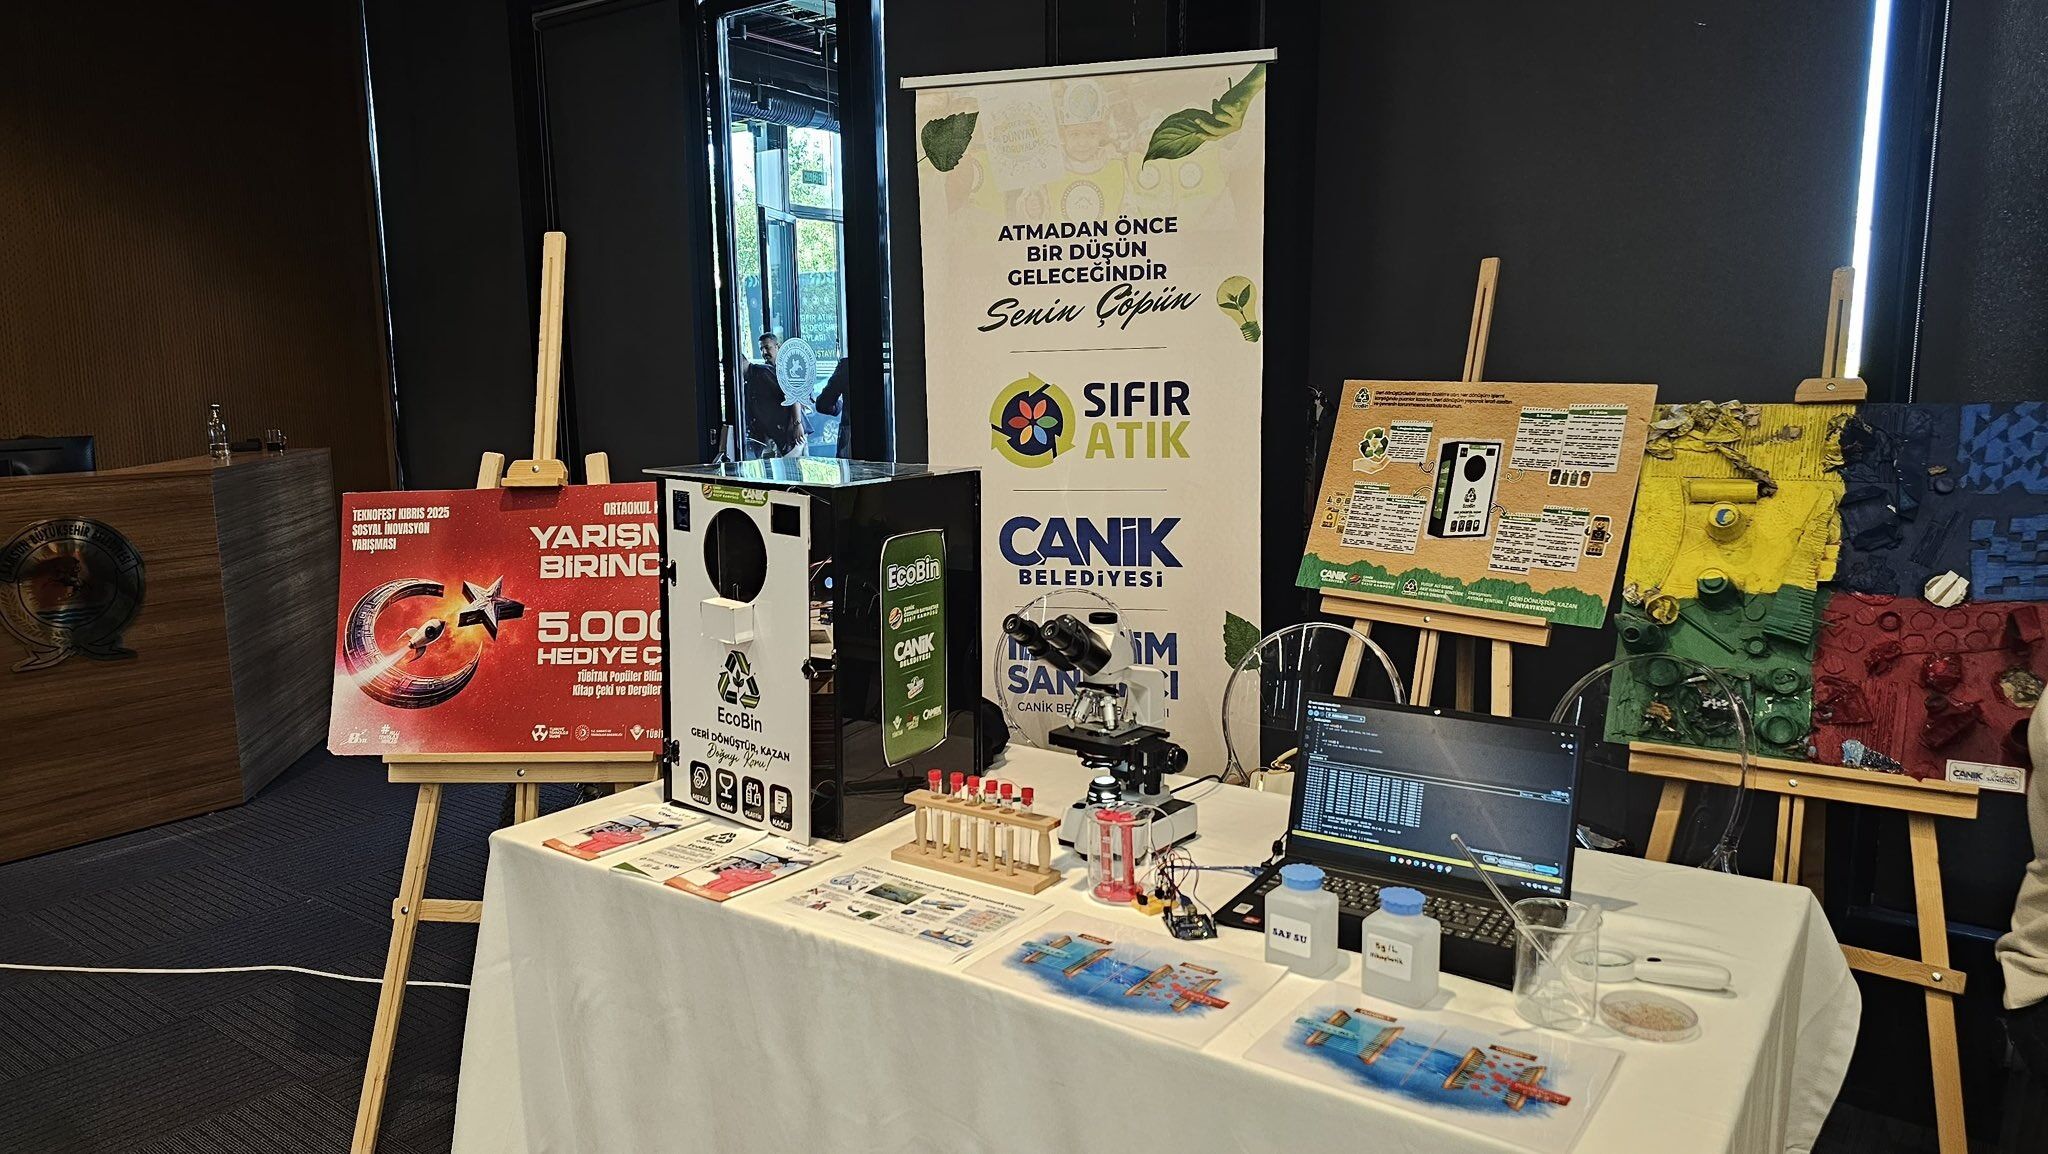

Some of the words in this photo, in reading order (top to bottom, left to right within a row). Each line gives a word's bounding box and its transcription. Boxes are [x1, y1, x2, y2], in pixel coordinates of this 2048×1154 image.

[998, 220, 1108, 242] ATMADAN
[1115, 215, 1178, 235] ÖNCE
[1027, 244, 1062, 262] BİR
[1069, 241, 1147, 264] DÜŞÜN
[1007, 259, 1168, 286] GELECEĞİNDİR
[977, 298, 1085, 332] Senin
[1096, 283, 1202, 331] Çöpün
[1083, 380, 1191, 417] SIFIR
[1085, 420, 1191, 459] ATIK
[352, 507, 397, 522] TEKNOFEST
[398, 507, 425, 520] KIBRIS
[426, 506, 450, 519] 2025
[603, 501, 652, 516] ORTAOKUL
[352, 522, 383, 536] SOSYAL
[384, 520, 430, 535] İNOVASYON
[352, 537, 397, 554] YARIŞMASI
[999, 516, 1184, 567] CANİK
[887, 555, 942, 591] EcoBin
[1018, 569, 1163, 588] BELEDİYESİ
[1320, 569, 1348, 581] CANİK
[537, 646, 637, 665] HEDİYE
[642, 646, 662, 666] Ç
[893, 632, 936, 662] CANİK
[577, 670, 608, 683] TÜBİTAK
[609, 669, 643, 685] Popüler
[572, 684, 594, 698] Kitap
[595, 684, 614, 699] Çeki
[615, 685, 626, 696] ve
[627, 683, 662, 698] Dergiler
[1017, 700, 1053, 713] CANİK
[717, 706, 763, 733] EcoBin
[691, 727, 710, 740] GERİ
[760, 745, 790, 762] KAZAN
[720, 801, 734, 812] CAM
[772, 818, 790, 830] KAĞIT
[1272, 927, 1291, 940] SAF
[1293, 933, 1307, 944] SU
